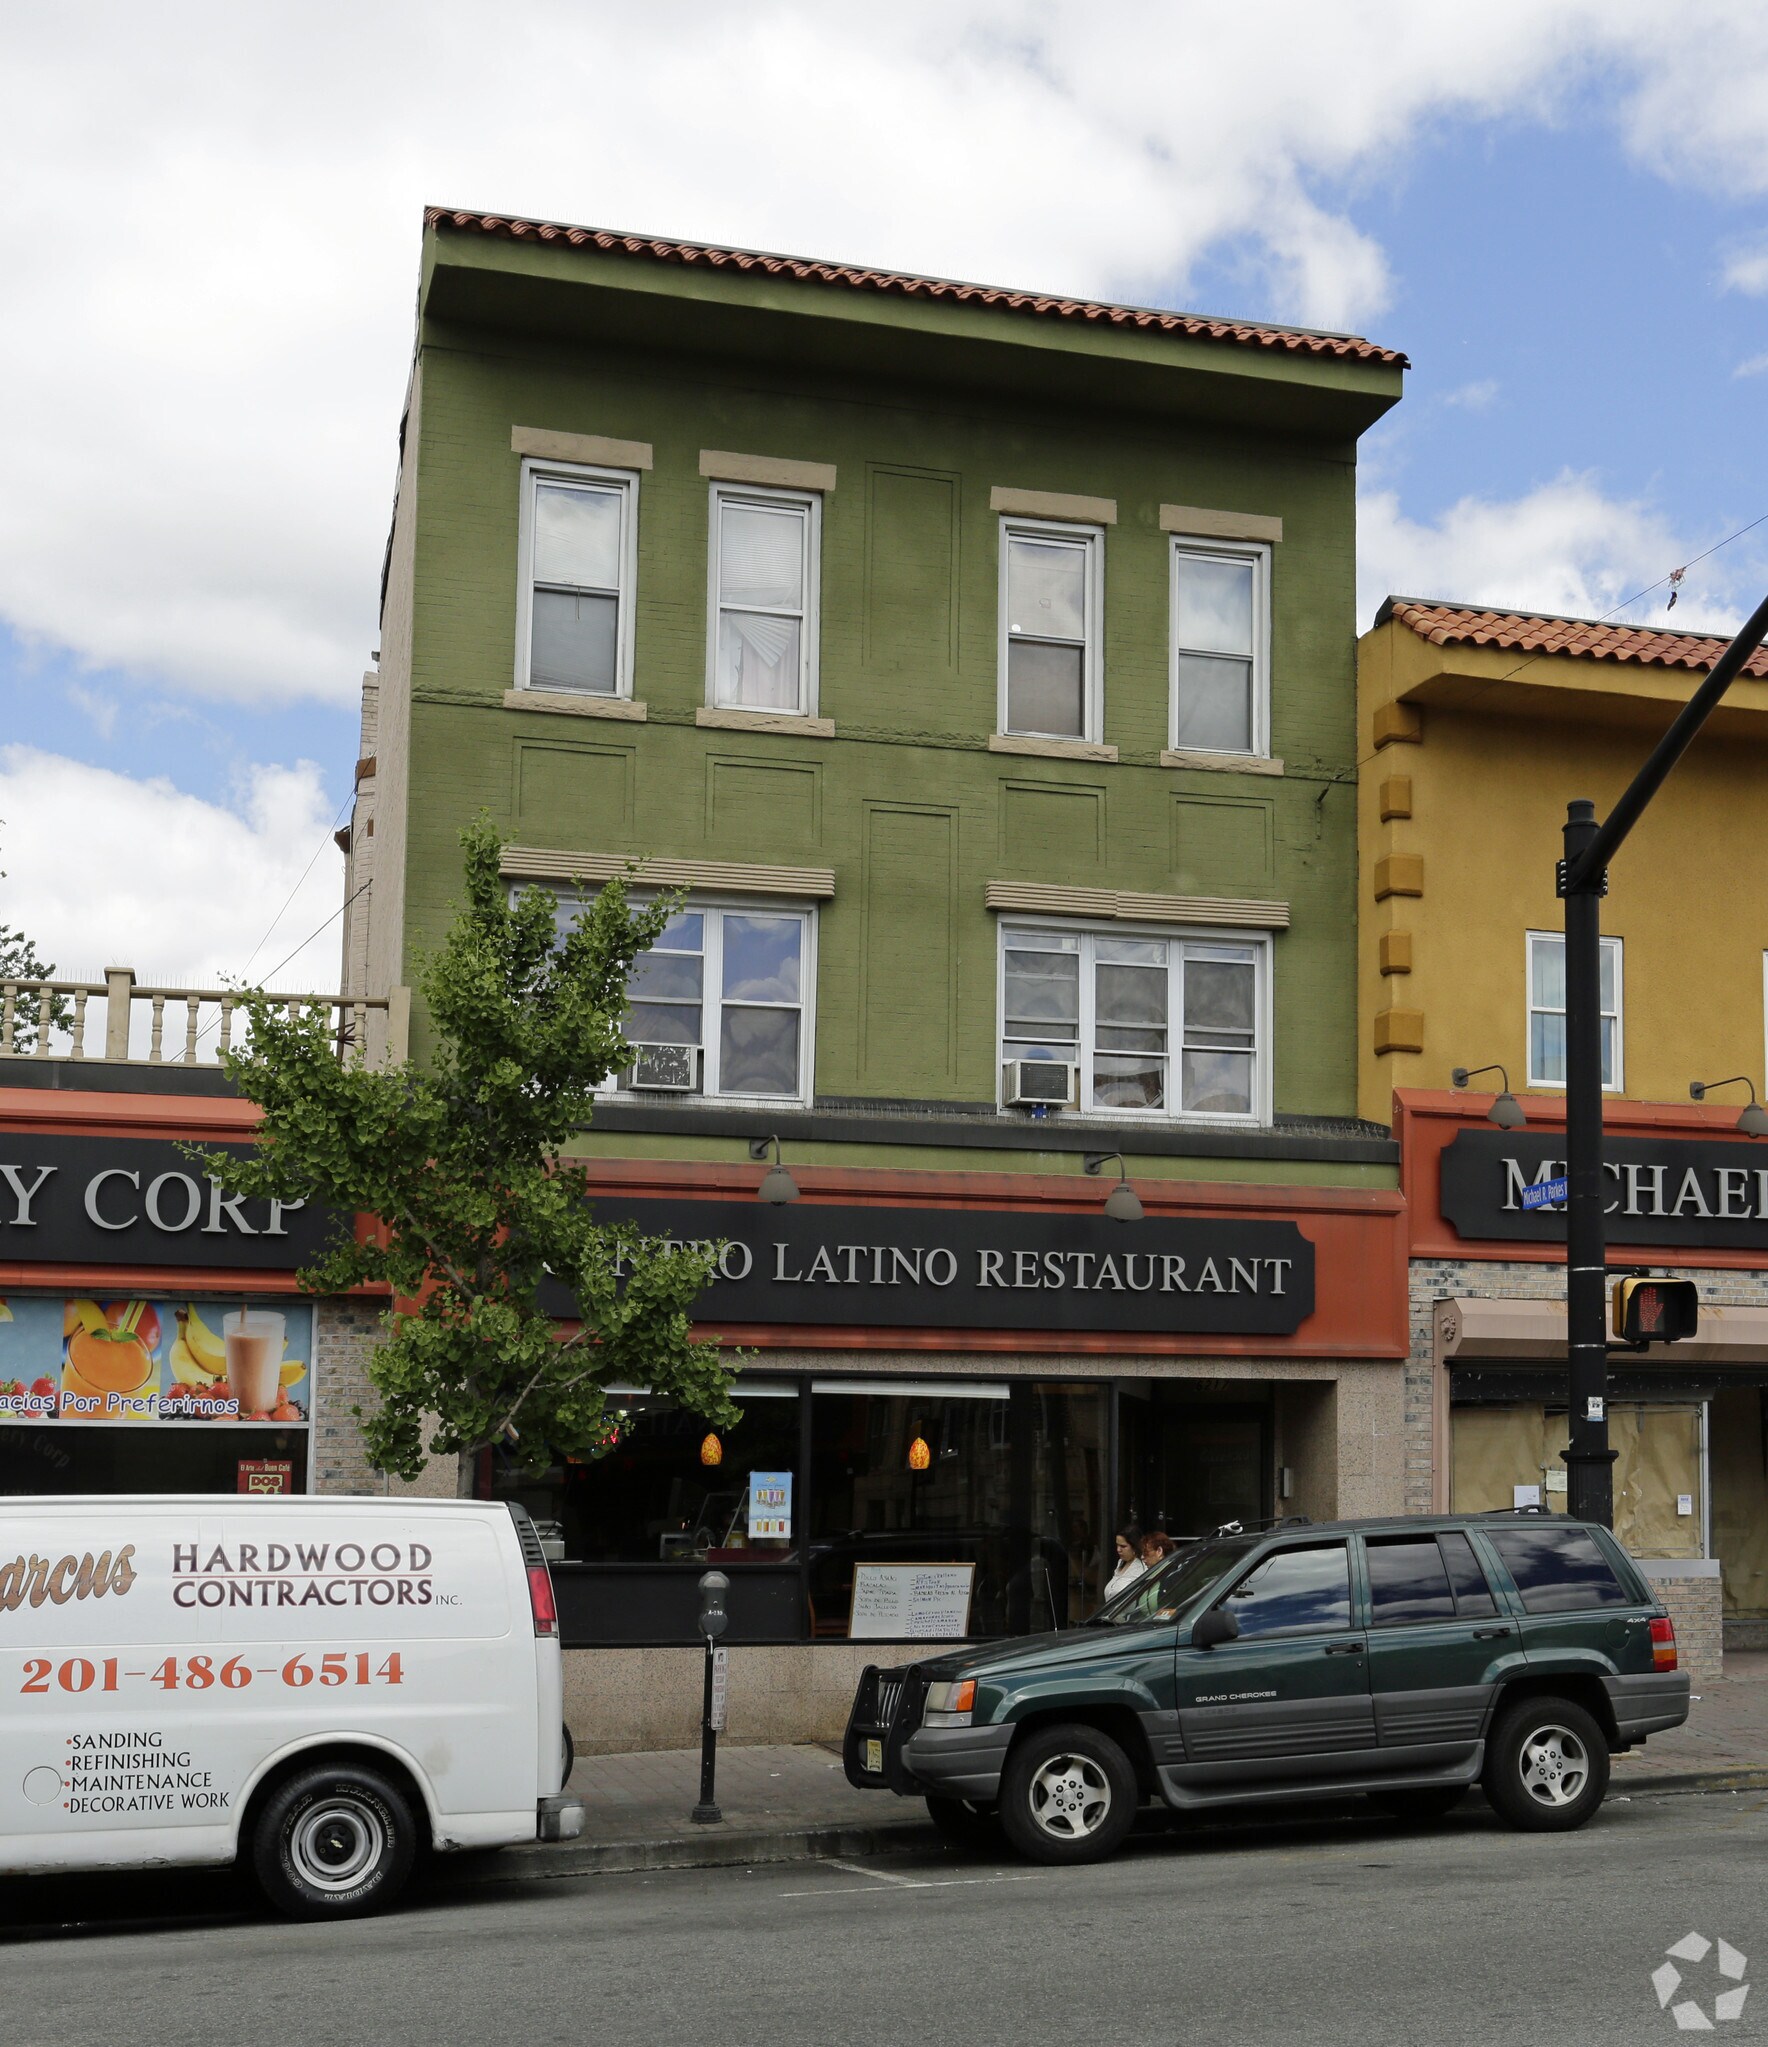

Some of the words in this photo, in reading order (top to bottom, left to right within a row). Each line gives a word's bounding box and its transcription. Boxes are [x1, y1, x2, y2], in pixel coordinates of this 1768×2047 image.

[84, 1168, 310, 1235] CORP
[772, 1242, 957, 1287] LATINO
[975, 1248, 1292, 1296] RESTAURANT
[62, 1392, 100, 1412] Por
[106, 1391, 239, 1414] Preferirnos
[251, 1476, 280, 1486] DOS
[172, 1543, 432, 1574] HARDWOOD
[172, 1578, 432, 1608] CONTRACTORS
[435, 1594, 463, 1606] INC.
[19, 1652, 405, 1694] 201-486-6514
[1195, 1694, 1228, 1703] GRAND
[1229, 1690, 1277, 1701] CHEROKEE
[72, 1731, 163, 1750] SANDING
[71, 1752, 192, 1770] REFINISHING
[71, 1771, 213, 1793] MAINTENANCE
[69, 1793, 176, 1813] DECORATIVE
[181, 1791, 230, 1809] WORK
